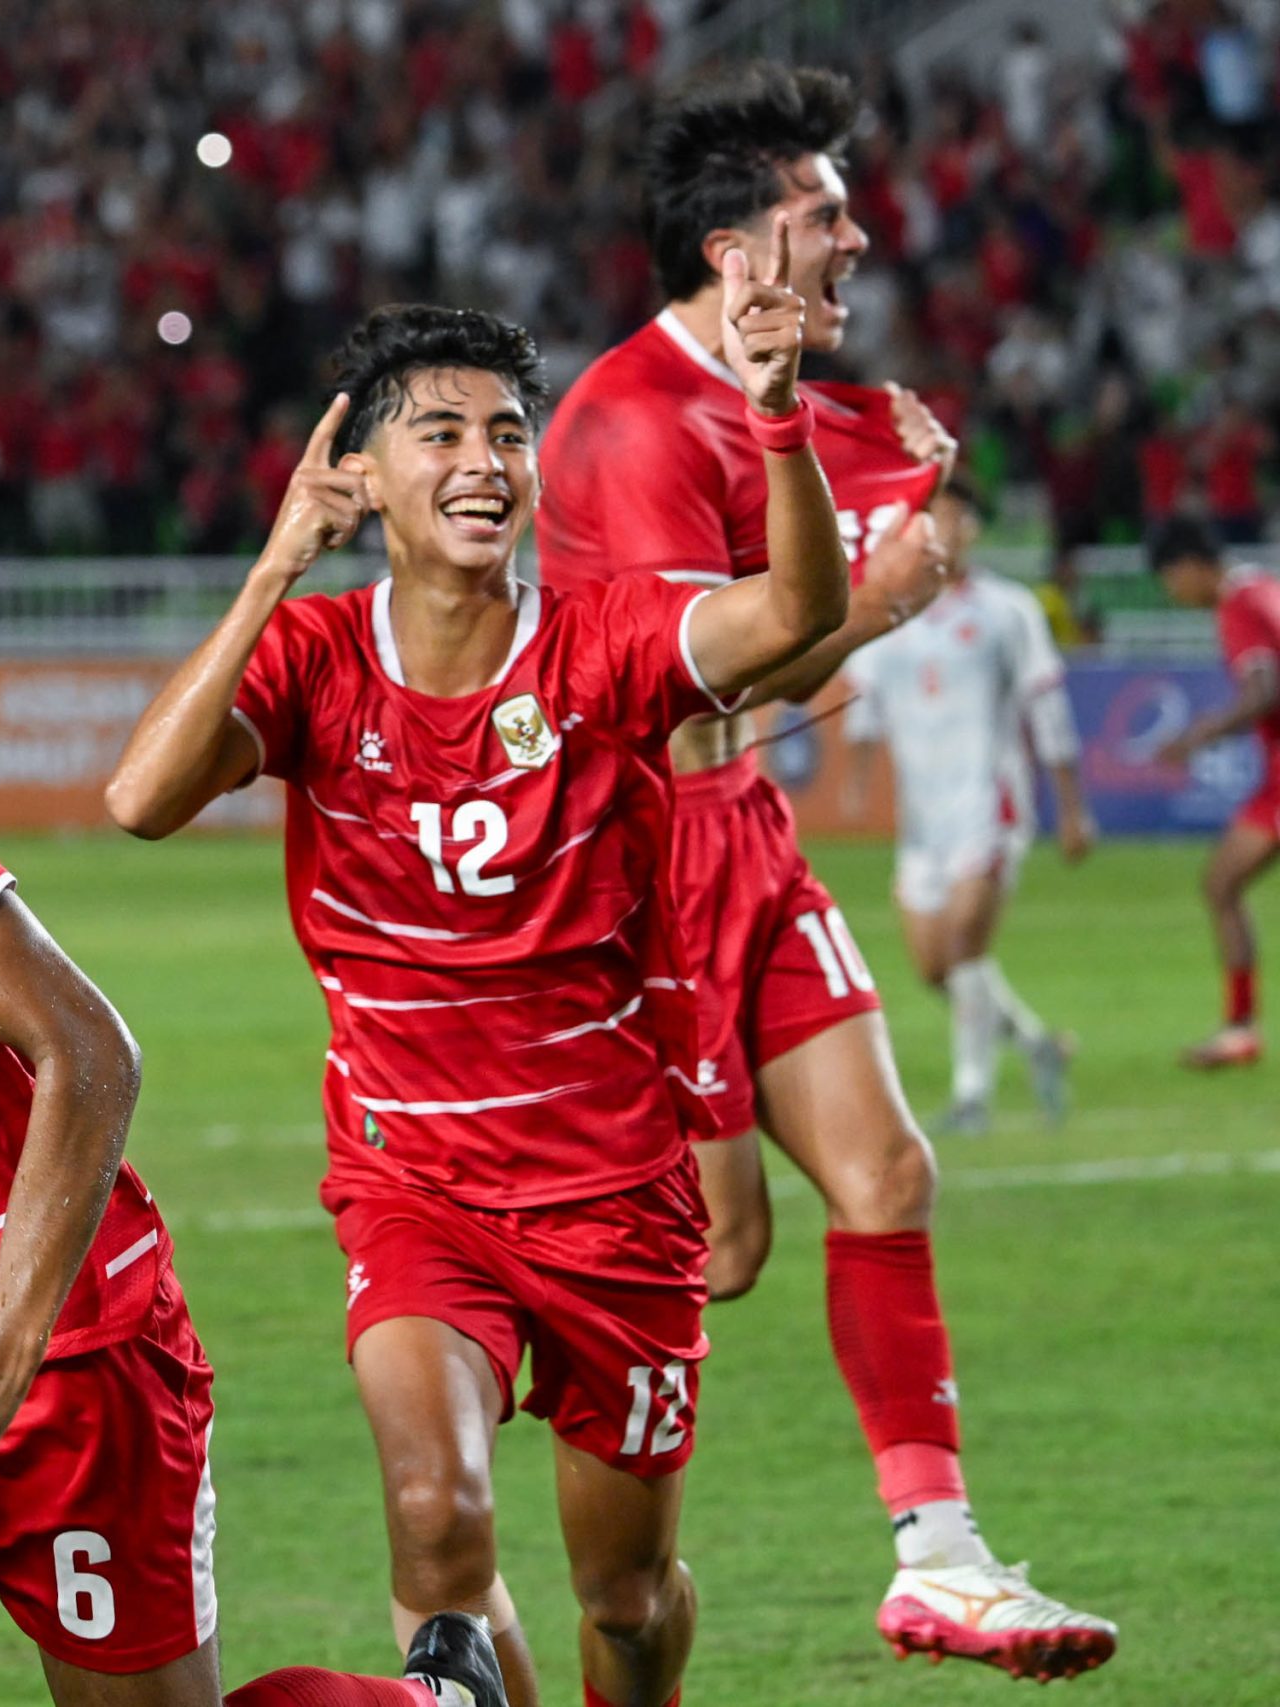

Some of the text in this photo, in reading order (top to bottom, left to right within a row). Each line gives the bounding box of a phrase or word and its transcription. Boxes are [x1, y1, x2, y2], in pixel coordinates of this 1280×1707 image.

[410, 800, 516, 897] 12
[795, 906, 875, 999] 10
[619, 1358, 691, 1456] 12
[53, 1530, 116, 1640] 6
